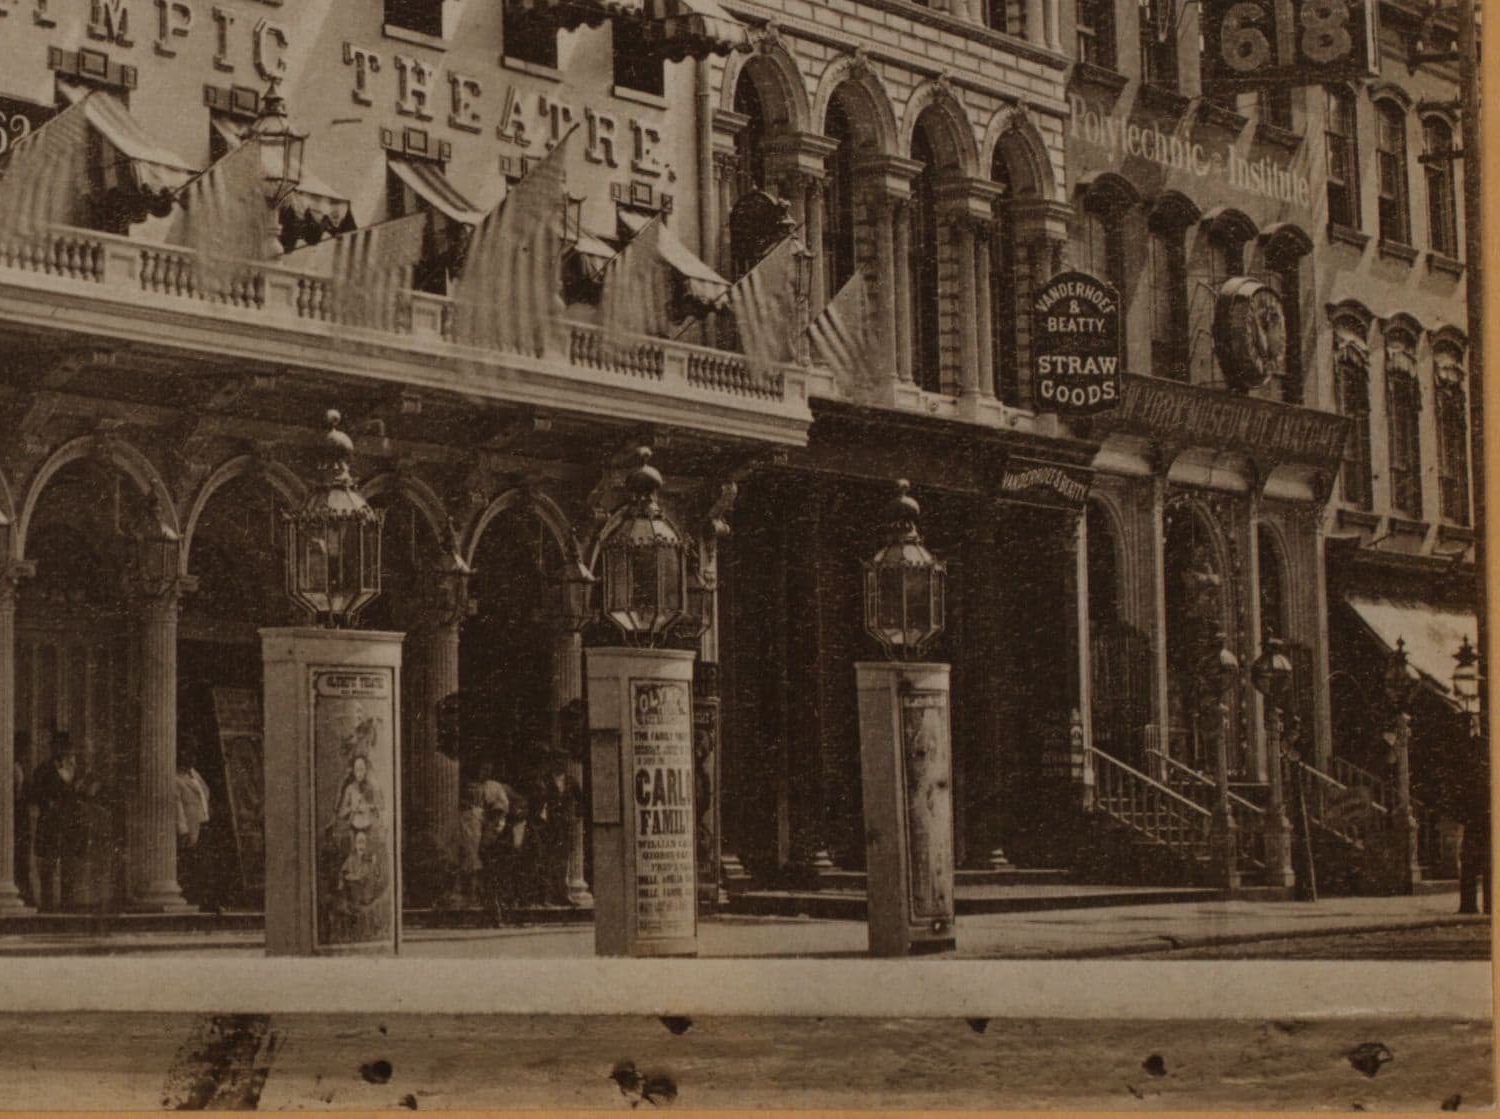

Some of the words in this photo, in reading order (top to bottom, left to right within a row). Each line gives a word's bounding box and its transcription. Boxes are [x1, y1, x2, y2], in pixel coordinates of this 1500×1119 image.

[342, 40, 678, 184] THEATRE.
[1068, 91, 1211, 177] Polytechnic
[1228, 144, 1310, 209] Institute
[1034, 281, 1118, 313] VANDERHOEF
[1068, 299, 1081, 314] &
[1038, 355, 1118, 375] STRAW
[1041, 379, 1121, 406] GOODS.
[636, 768, 692, 807] CARL
[640, 809, 687, 835] FAMIL
